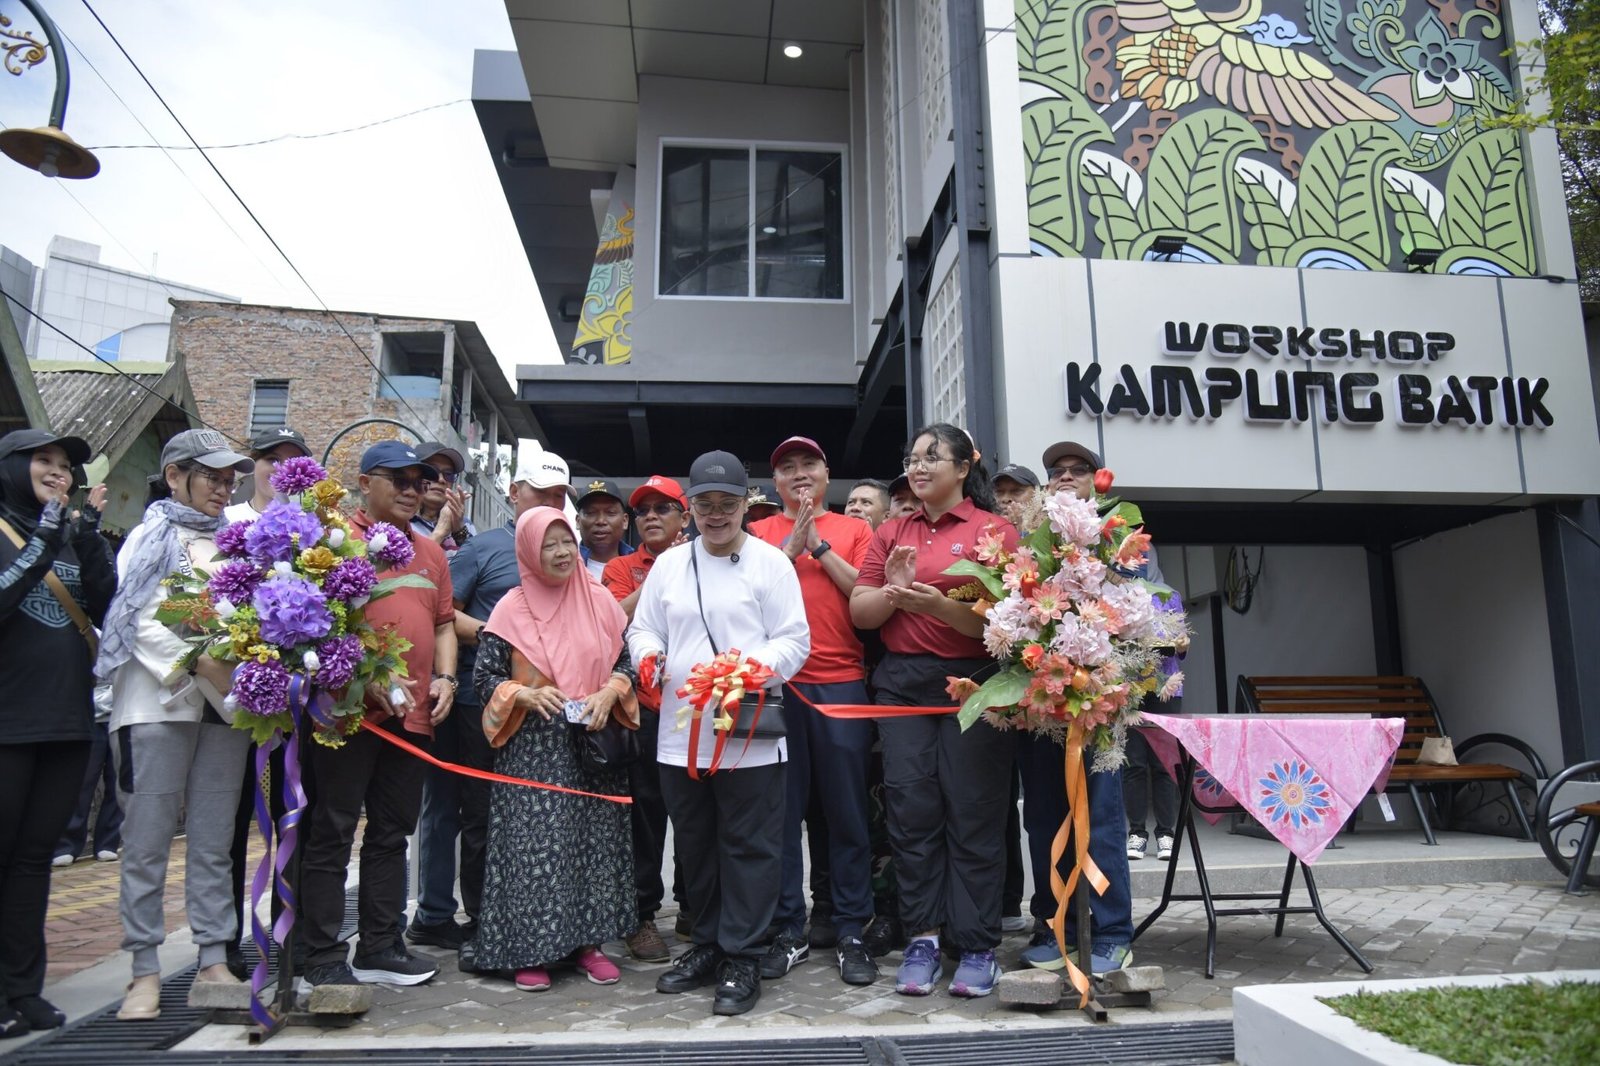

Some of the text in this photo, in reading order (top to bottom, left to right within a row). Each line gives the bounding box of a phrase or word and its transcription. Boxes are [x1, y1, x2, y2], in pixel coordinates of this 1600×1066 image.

[1164, 320, 1456, 361] WORKSHOP
[1066, 362, 1554, 427] KAMPUNG BATIK
[542, 464, 566, 475] CHANEL
